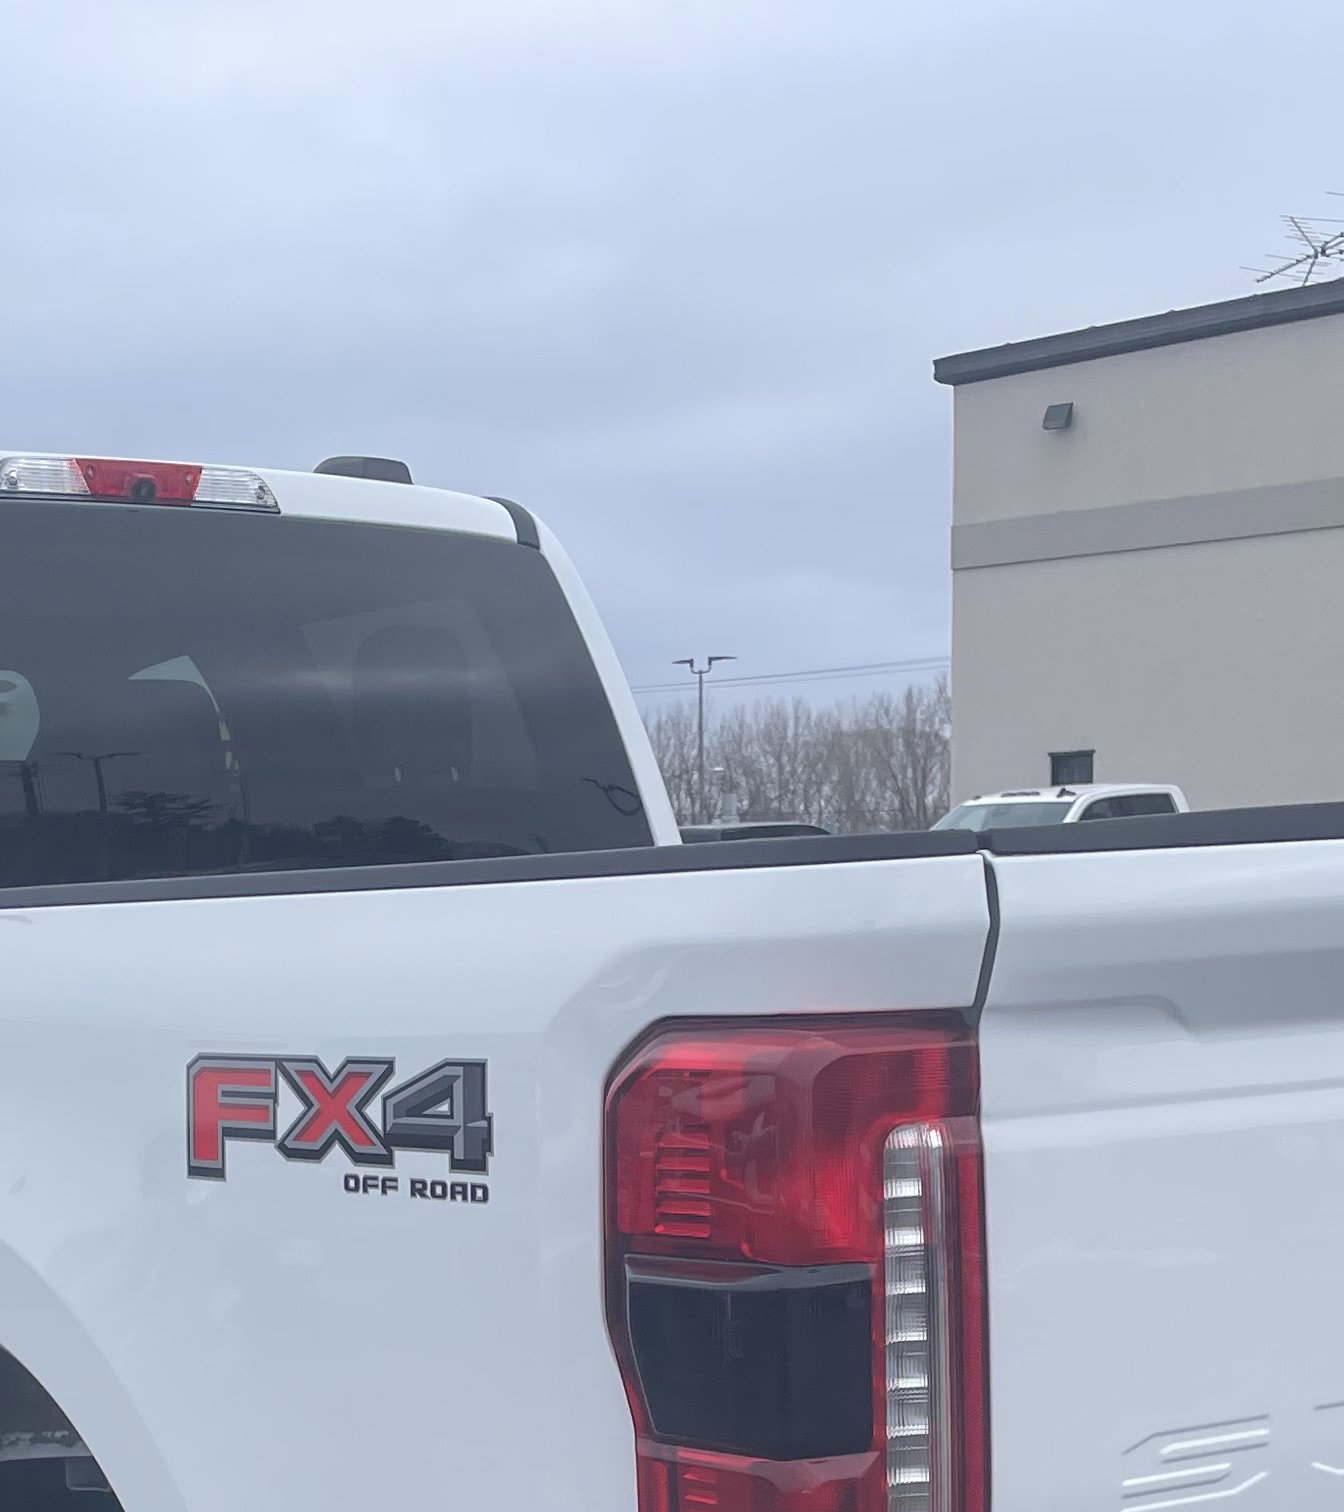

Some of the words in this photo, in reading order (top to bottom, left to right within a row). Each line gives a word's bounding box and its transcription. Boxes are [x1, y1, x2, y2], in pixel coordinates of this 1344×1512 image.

[186, 1052, 494, 1181] FX4
[344, 1173, 399, 1195] OFF
[409, 1177, 490, 1204] ROAD
